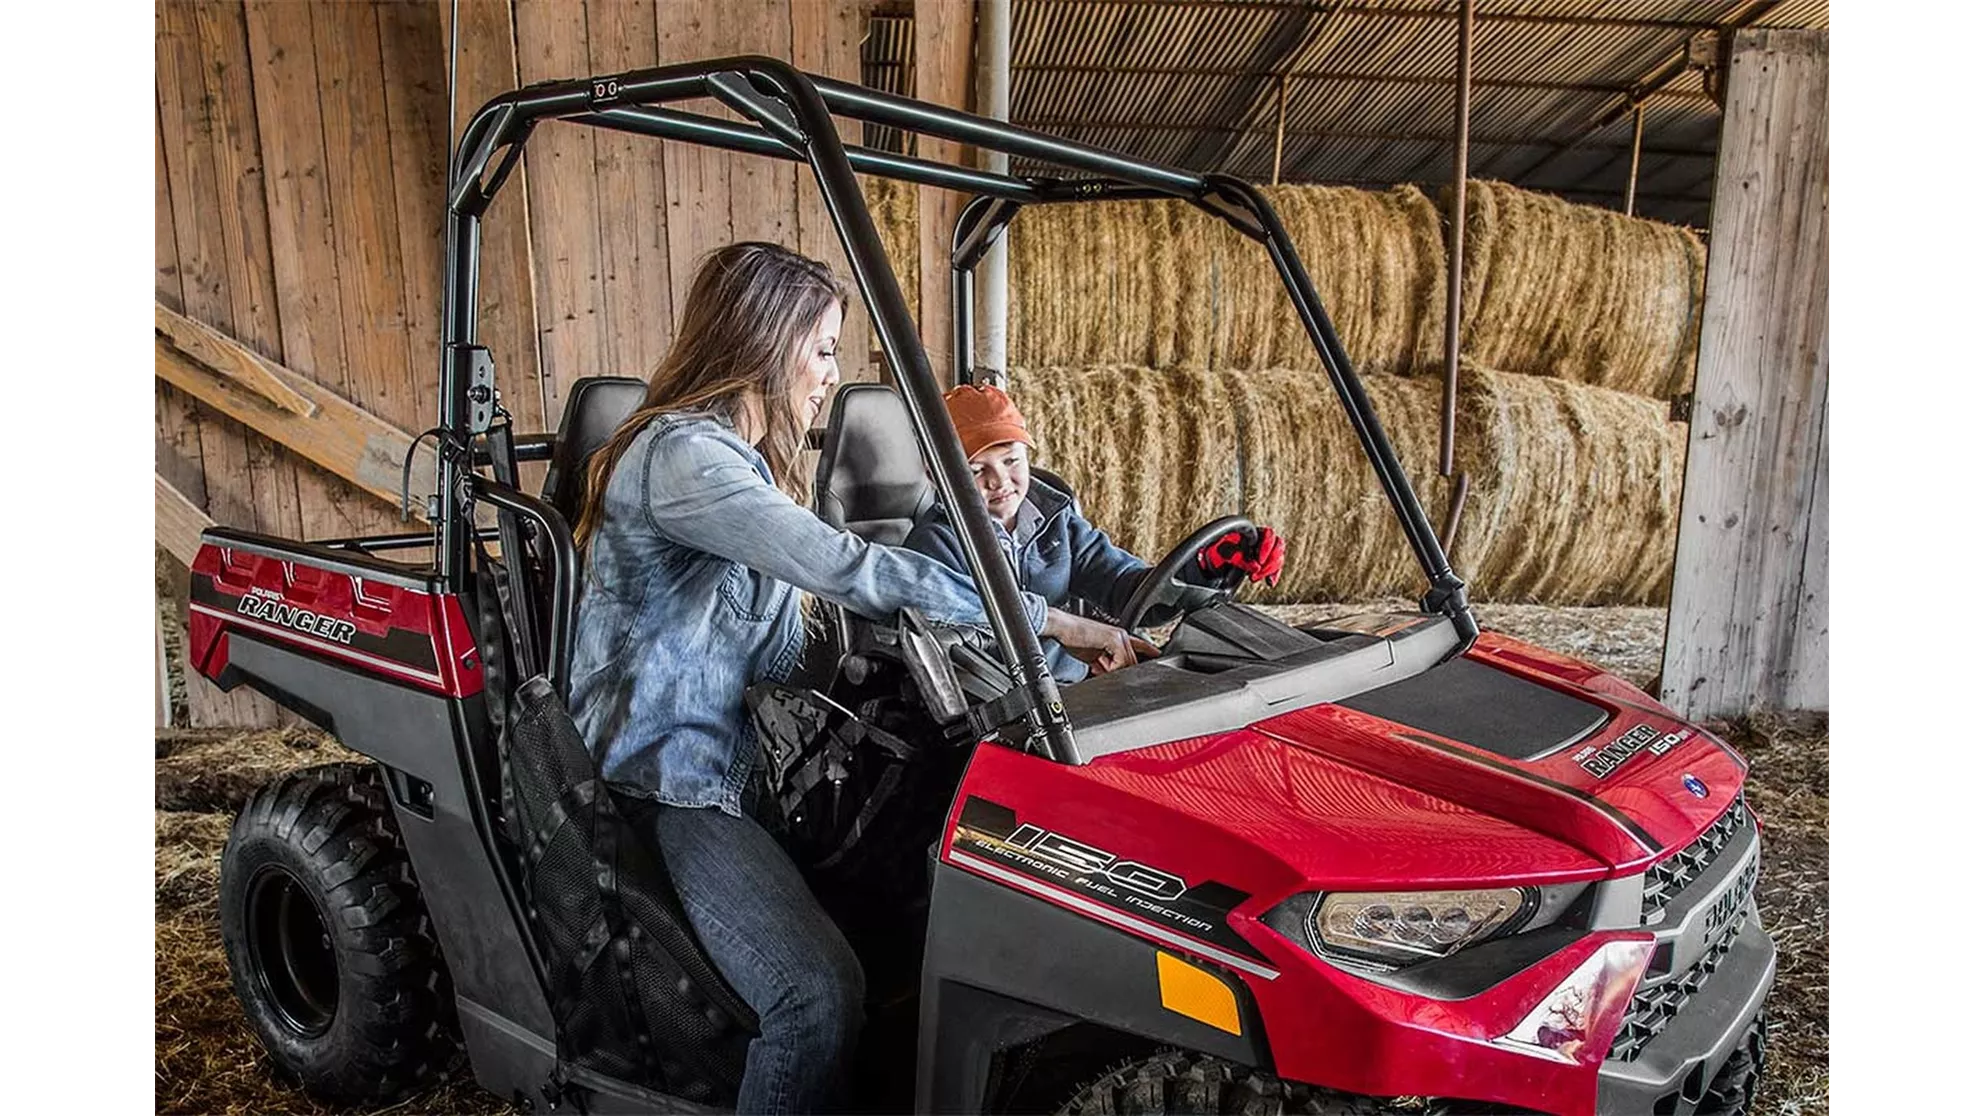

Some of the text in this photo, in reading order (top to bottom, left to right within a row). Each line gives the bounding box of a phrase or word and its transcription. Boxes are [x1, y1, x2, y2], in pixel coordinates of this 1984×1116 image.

[237, 593, 356, 645] RANGER
[1580, 723, 1661, 779] RANGER
[1648, 732, 1681, 757] 150
[975, 839, 1213, 932] ELECTRONIC FUEL INJECTION
[1004, 823, 1188, 901] 150
